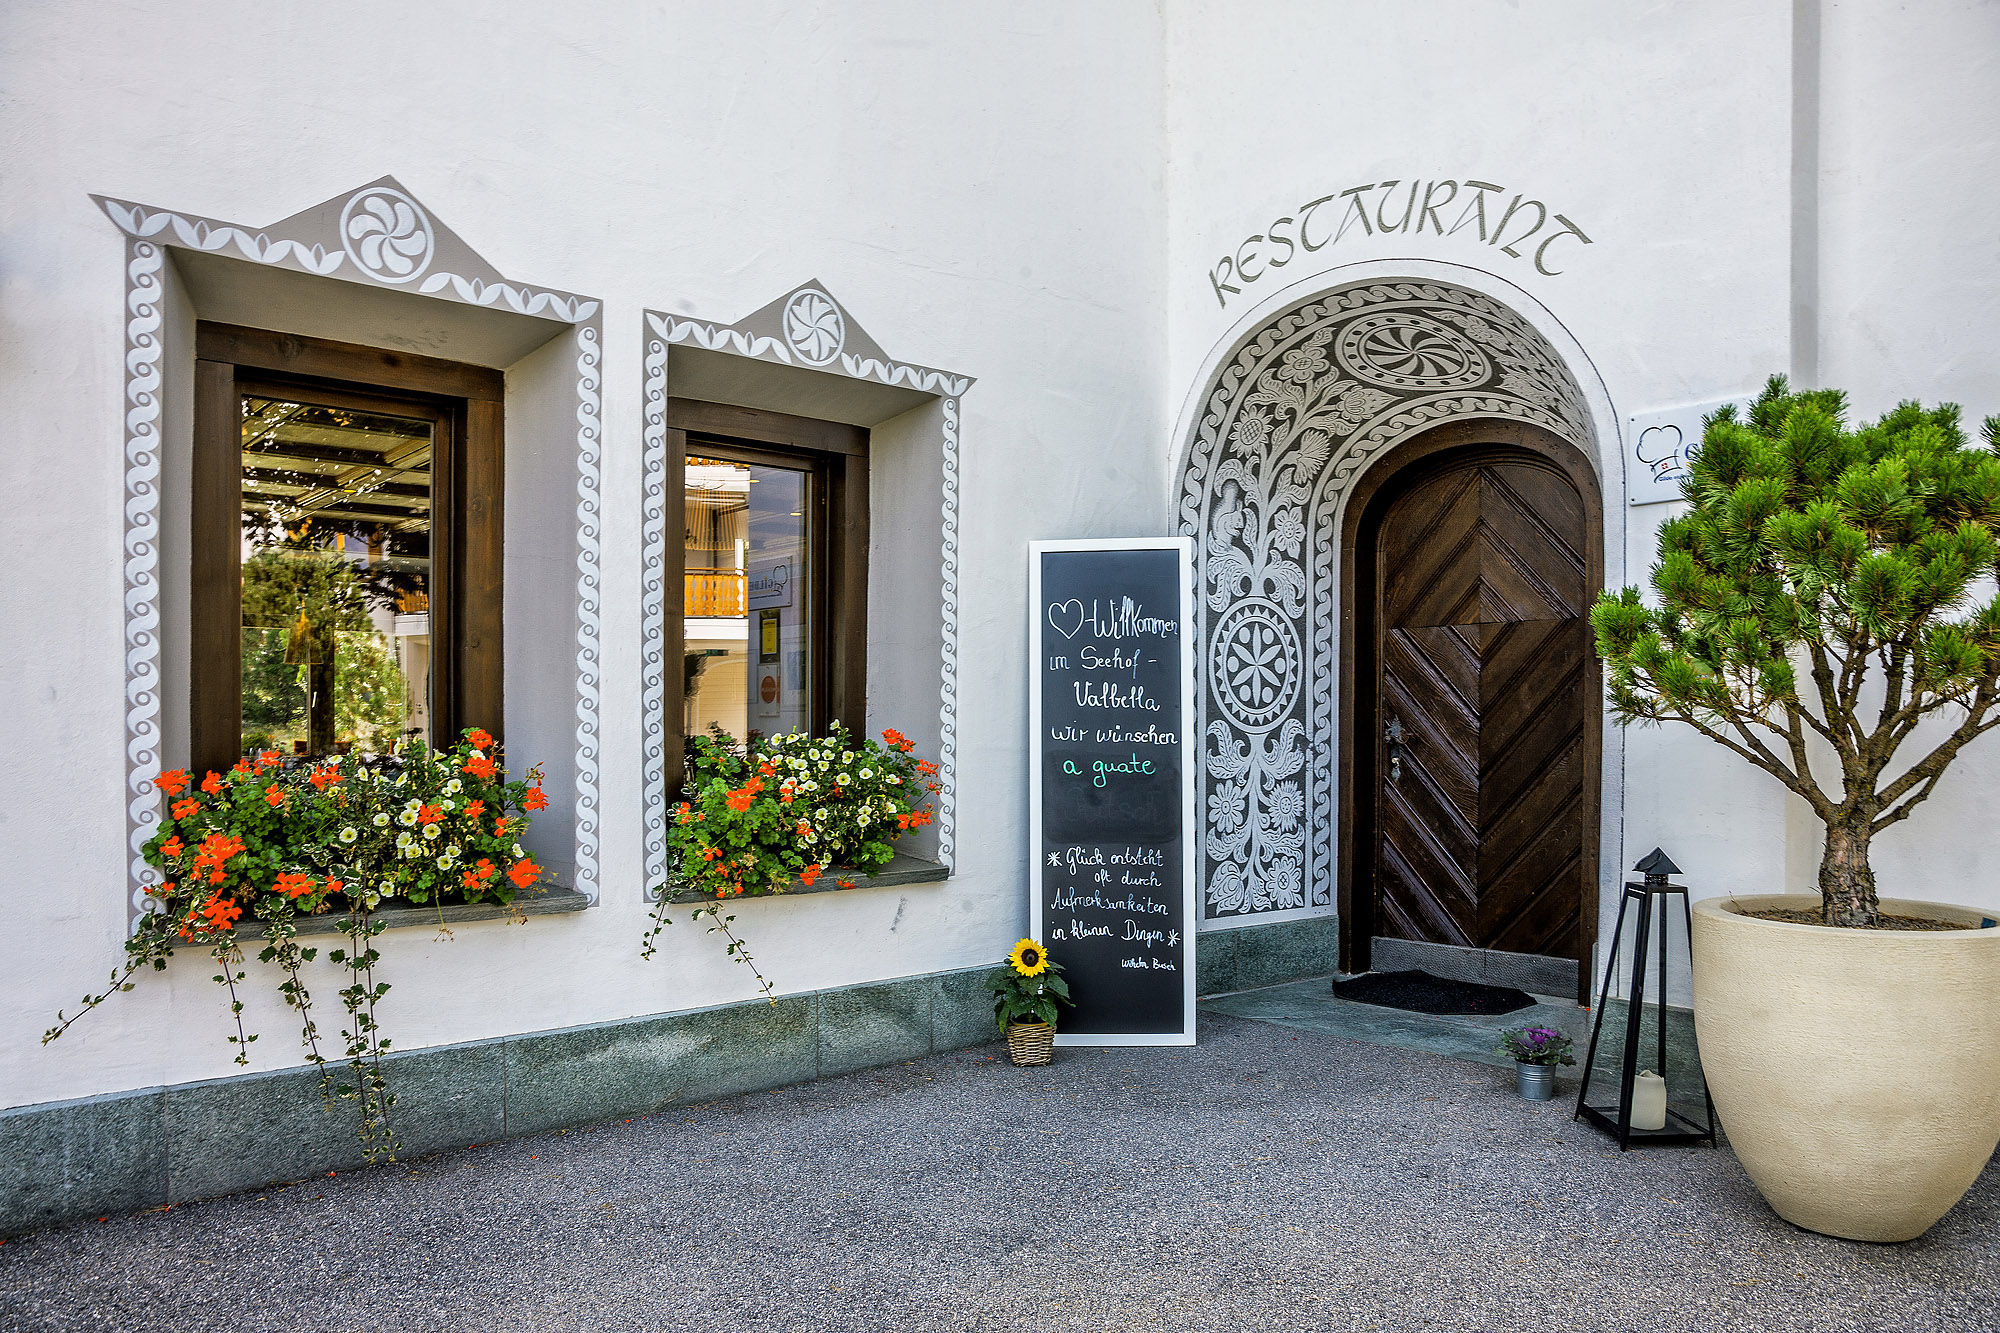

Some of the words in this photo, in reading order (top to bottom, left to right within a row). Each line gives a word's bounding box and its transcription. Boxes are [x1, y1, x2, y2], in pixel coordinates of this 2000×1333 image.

[1208, 178, 1594, 310] RESTAURANT
[1080, 645, 1141, 680] Seehof
[1073, 680, 1161, 712] Valbella
[1096, 724, 1179, 745] wünschen
[1062, 759, 1084, 776] a
[1092, 752, 1157, 788] guate
[1066, 846, 1107, 876] Glück
[1094, 868, 1113, 888] oft
[1121, 869, 1162, 887] durch
[1050, 886, 1169, 916] Aufmerksamkeiten
[1051, 921, 1068, 941] in
[1151, 957, 1177, 971] Busch
